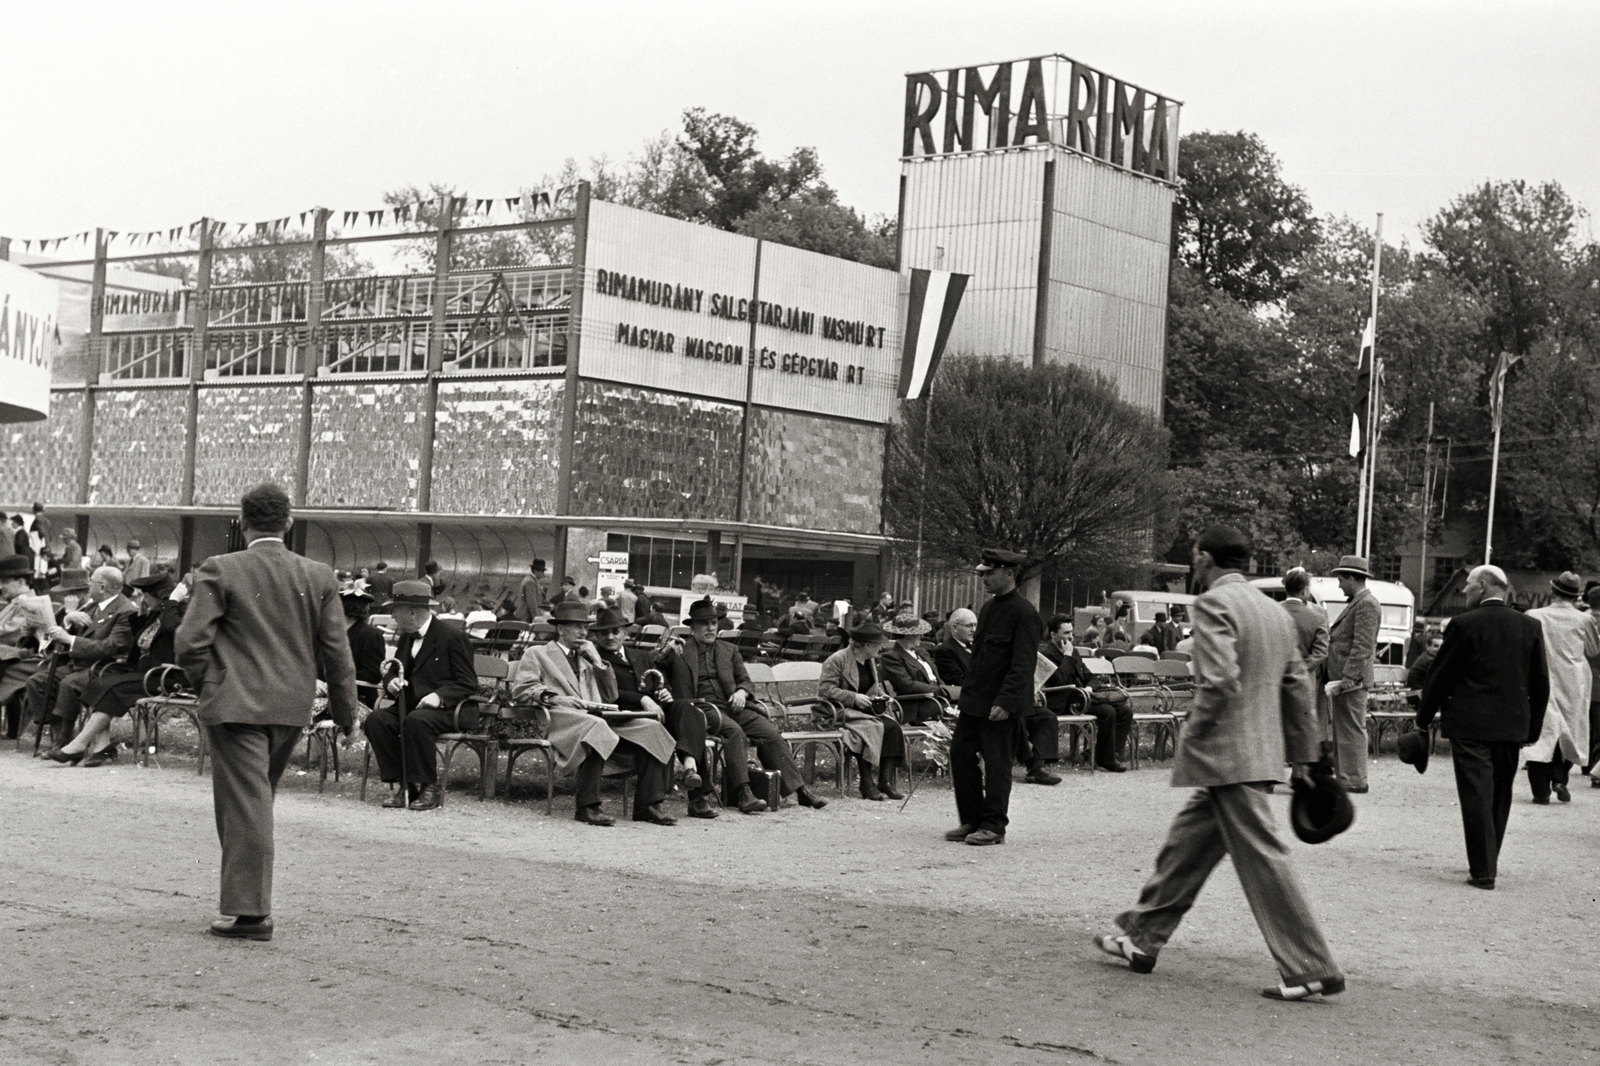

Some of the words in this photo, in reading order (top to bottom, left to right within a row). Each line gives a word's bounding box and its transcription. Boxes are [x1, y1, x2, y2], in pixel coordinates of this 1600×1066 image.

[903, 59, 1049, 157] RIMA
[1066, 61, 1169, 179] RIMA
[597, 269, 704, 313] RIMAMURÁNY
[618, 322, 675, 354] MAGYAR
[685, 336, 742, 366] WAGGON
[760, 347, 777, 370] ÉS
[783, 353, 838, 381] GÉPGYÁR
[848, 365, 864, 385] RT
